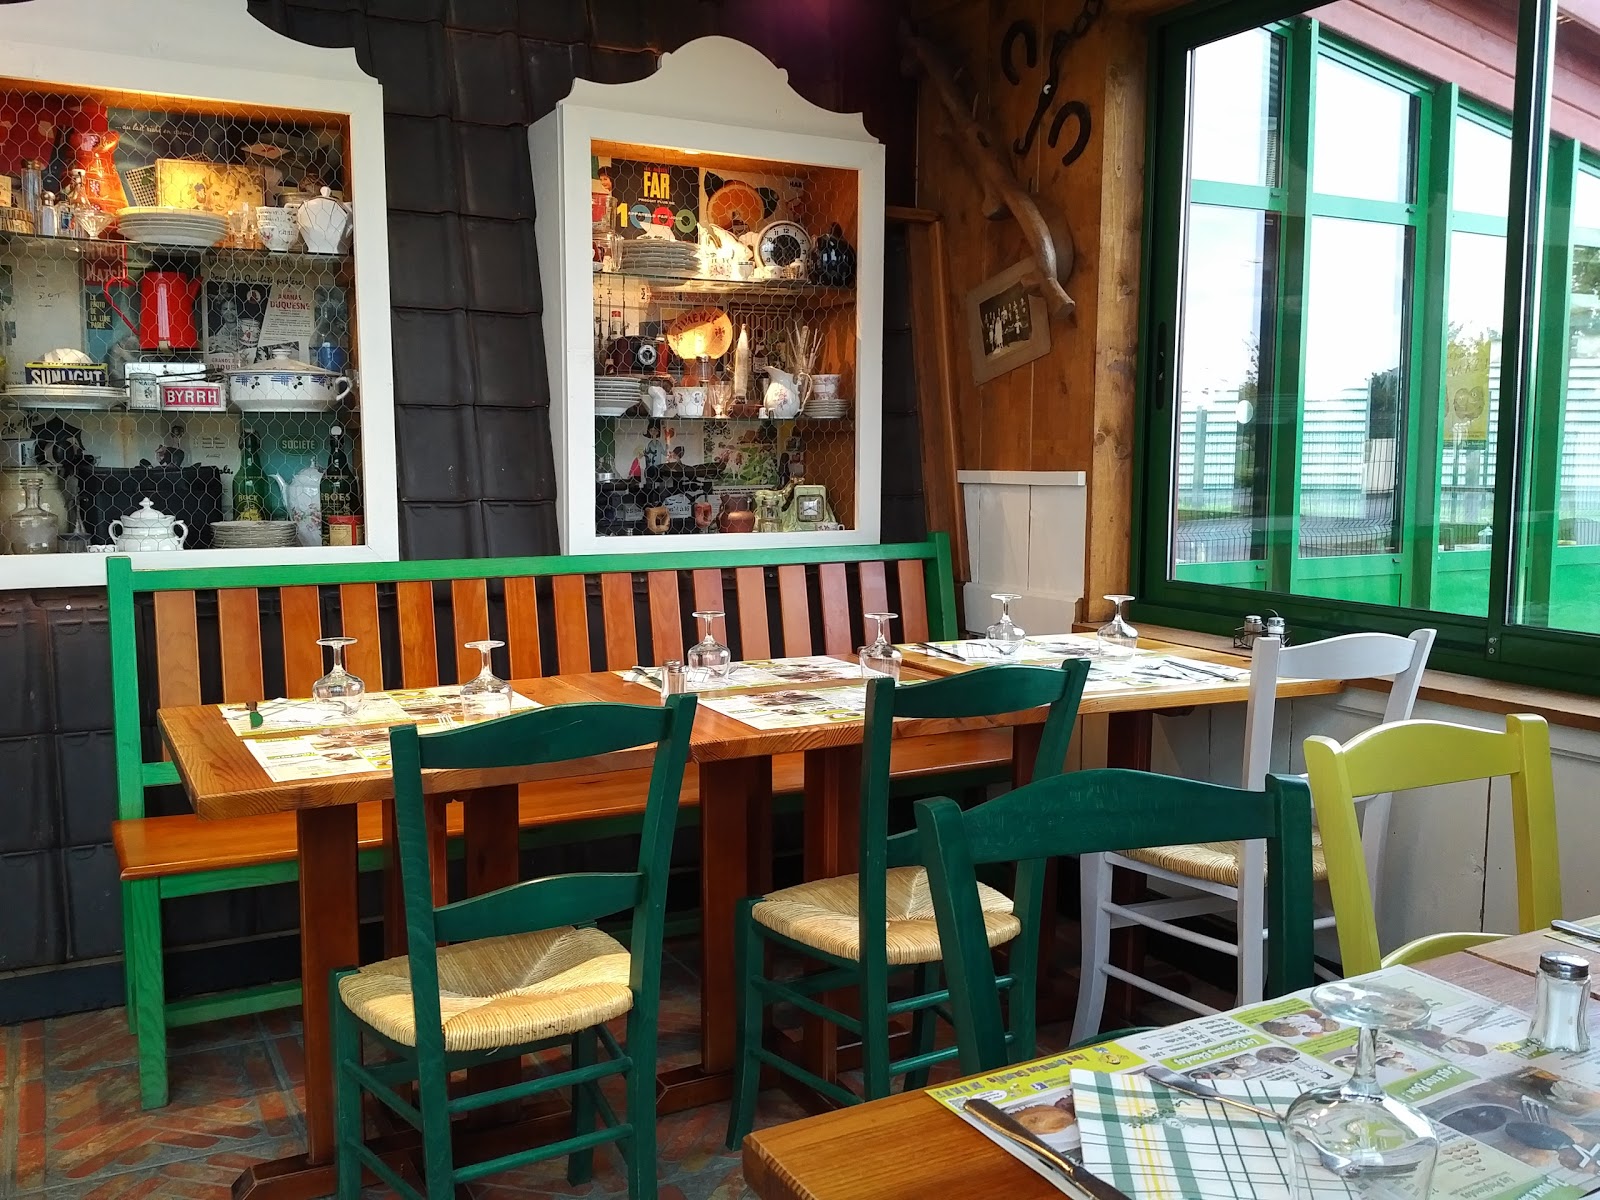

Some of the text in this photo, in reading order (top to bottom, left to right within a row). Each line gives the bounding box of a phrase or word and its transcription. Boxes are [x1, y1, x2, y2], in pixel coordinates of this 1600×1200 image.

[643, 171, 670, 199] FAR
[31, 369, 102, 386] SUNLIGHT
[167, 390, 217, 404] BYRRH
